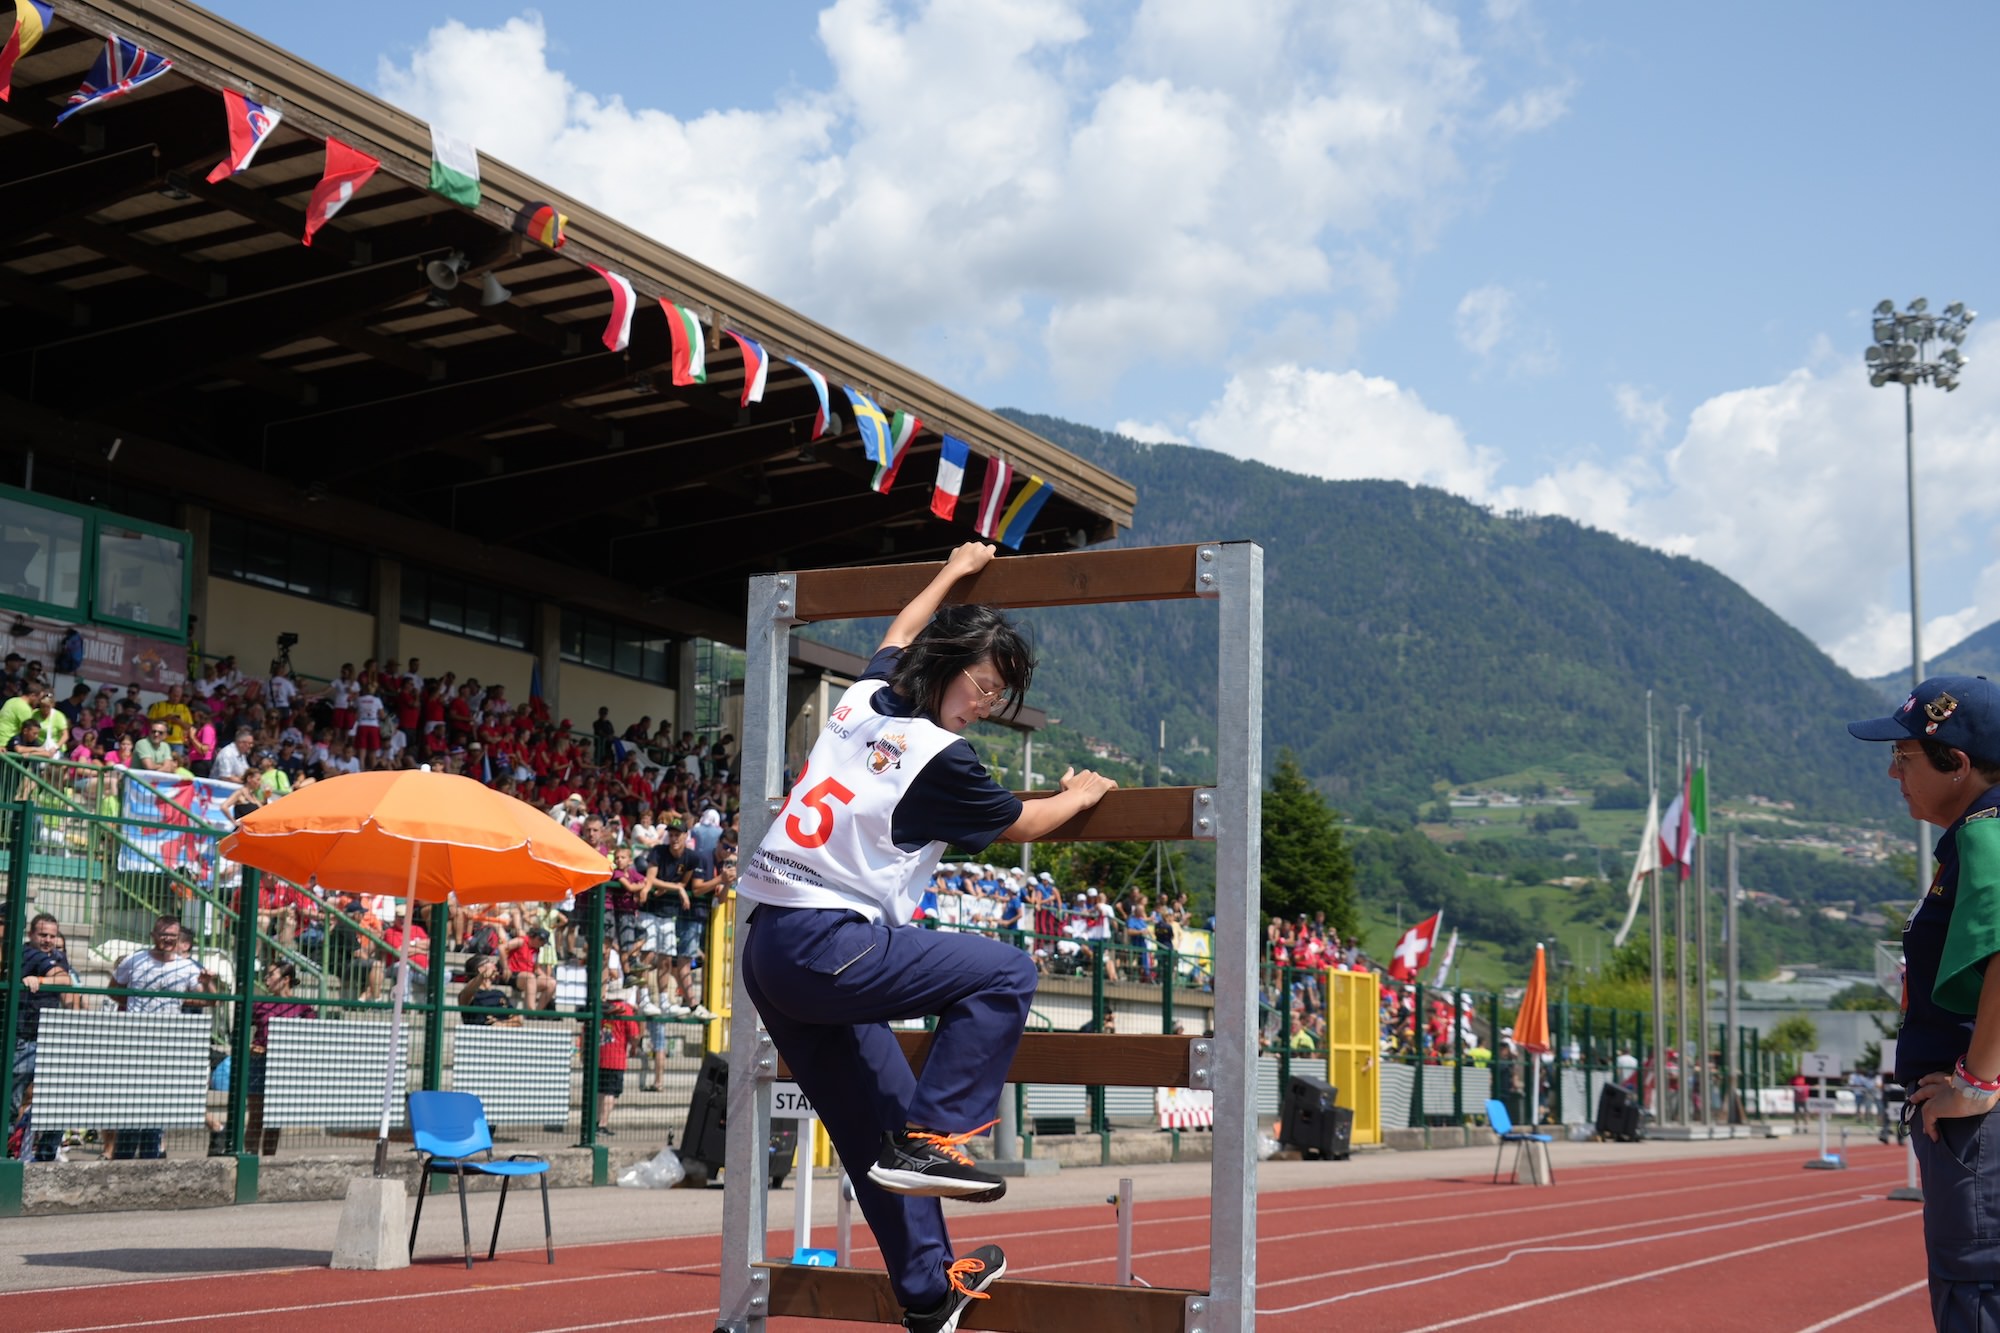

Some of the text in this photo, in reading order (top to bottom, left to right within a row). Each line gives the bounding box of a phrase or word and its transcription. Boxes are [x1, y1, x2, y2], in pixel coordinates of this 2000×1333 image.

[824, 719, 850, 740] IRUS
[879, 738, 902, 759] TRENTINO
[773, 759, 855, 848] 5
[759, 862, 787, 877] ALLIEVI
[786, 872, 803, 882] CTIF
[1817, 1060, 1826, 1073] 2
